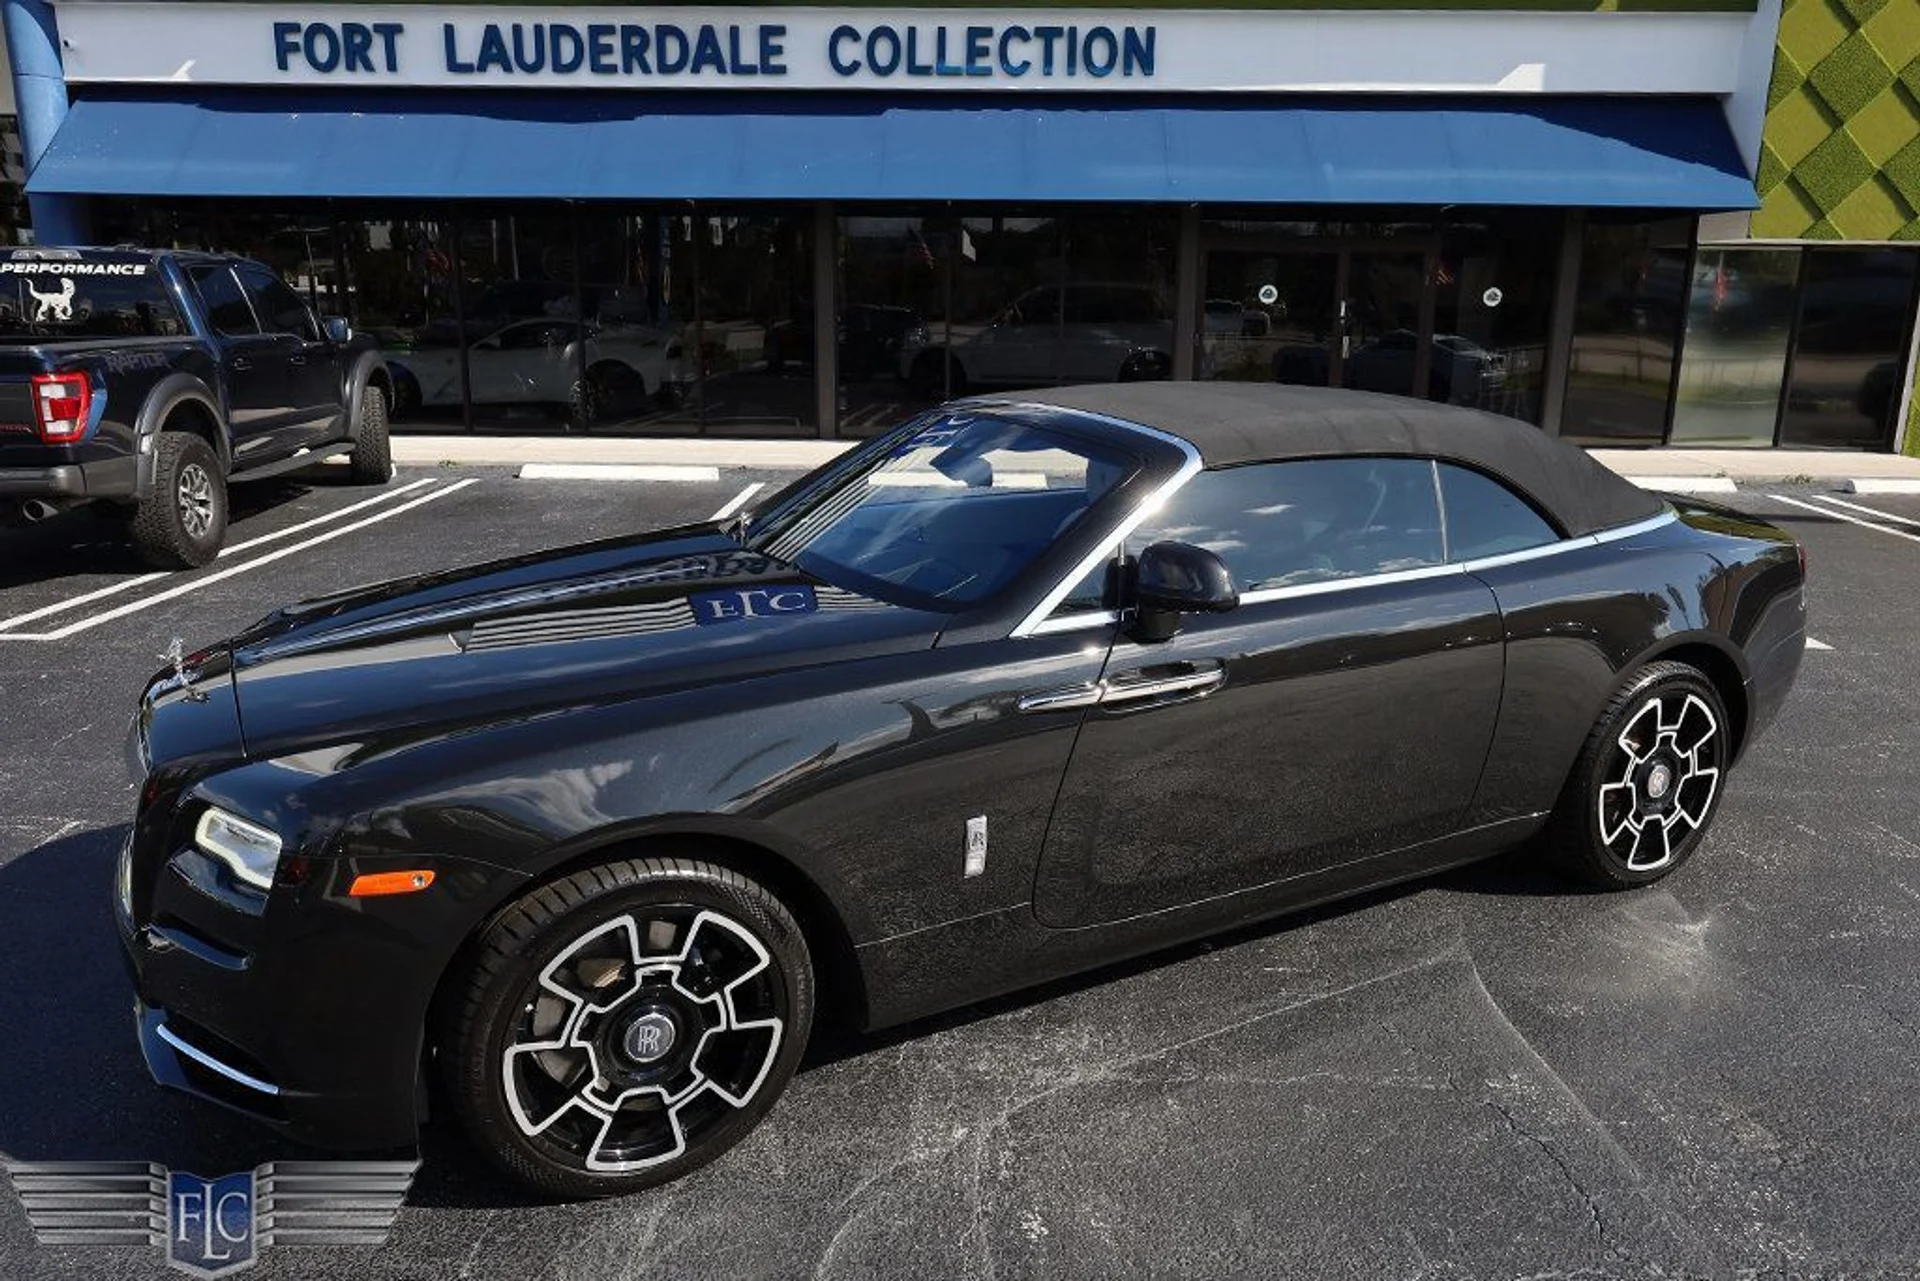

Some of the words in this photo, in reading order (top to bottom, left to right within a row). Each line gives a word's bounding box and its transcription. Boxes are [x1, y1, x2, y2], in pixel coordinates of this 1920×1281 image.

[273, 22, 404, 72] FORT
[443, 23, 787, 75] LAUDERDALE
[828, 24, 1156, 76] COLLECTION
[0, 263, 147, 275] PERFORMANCE
